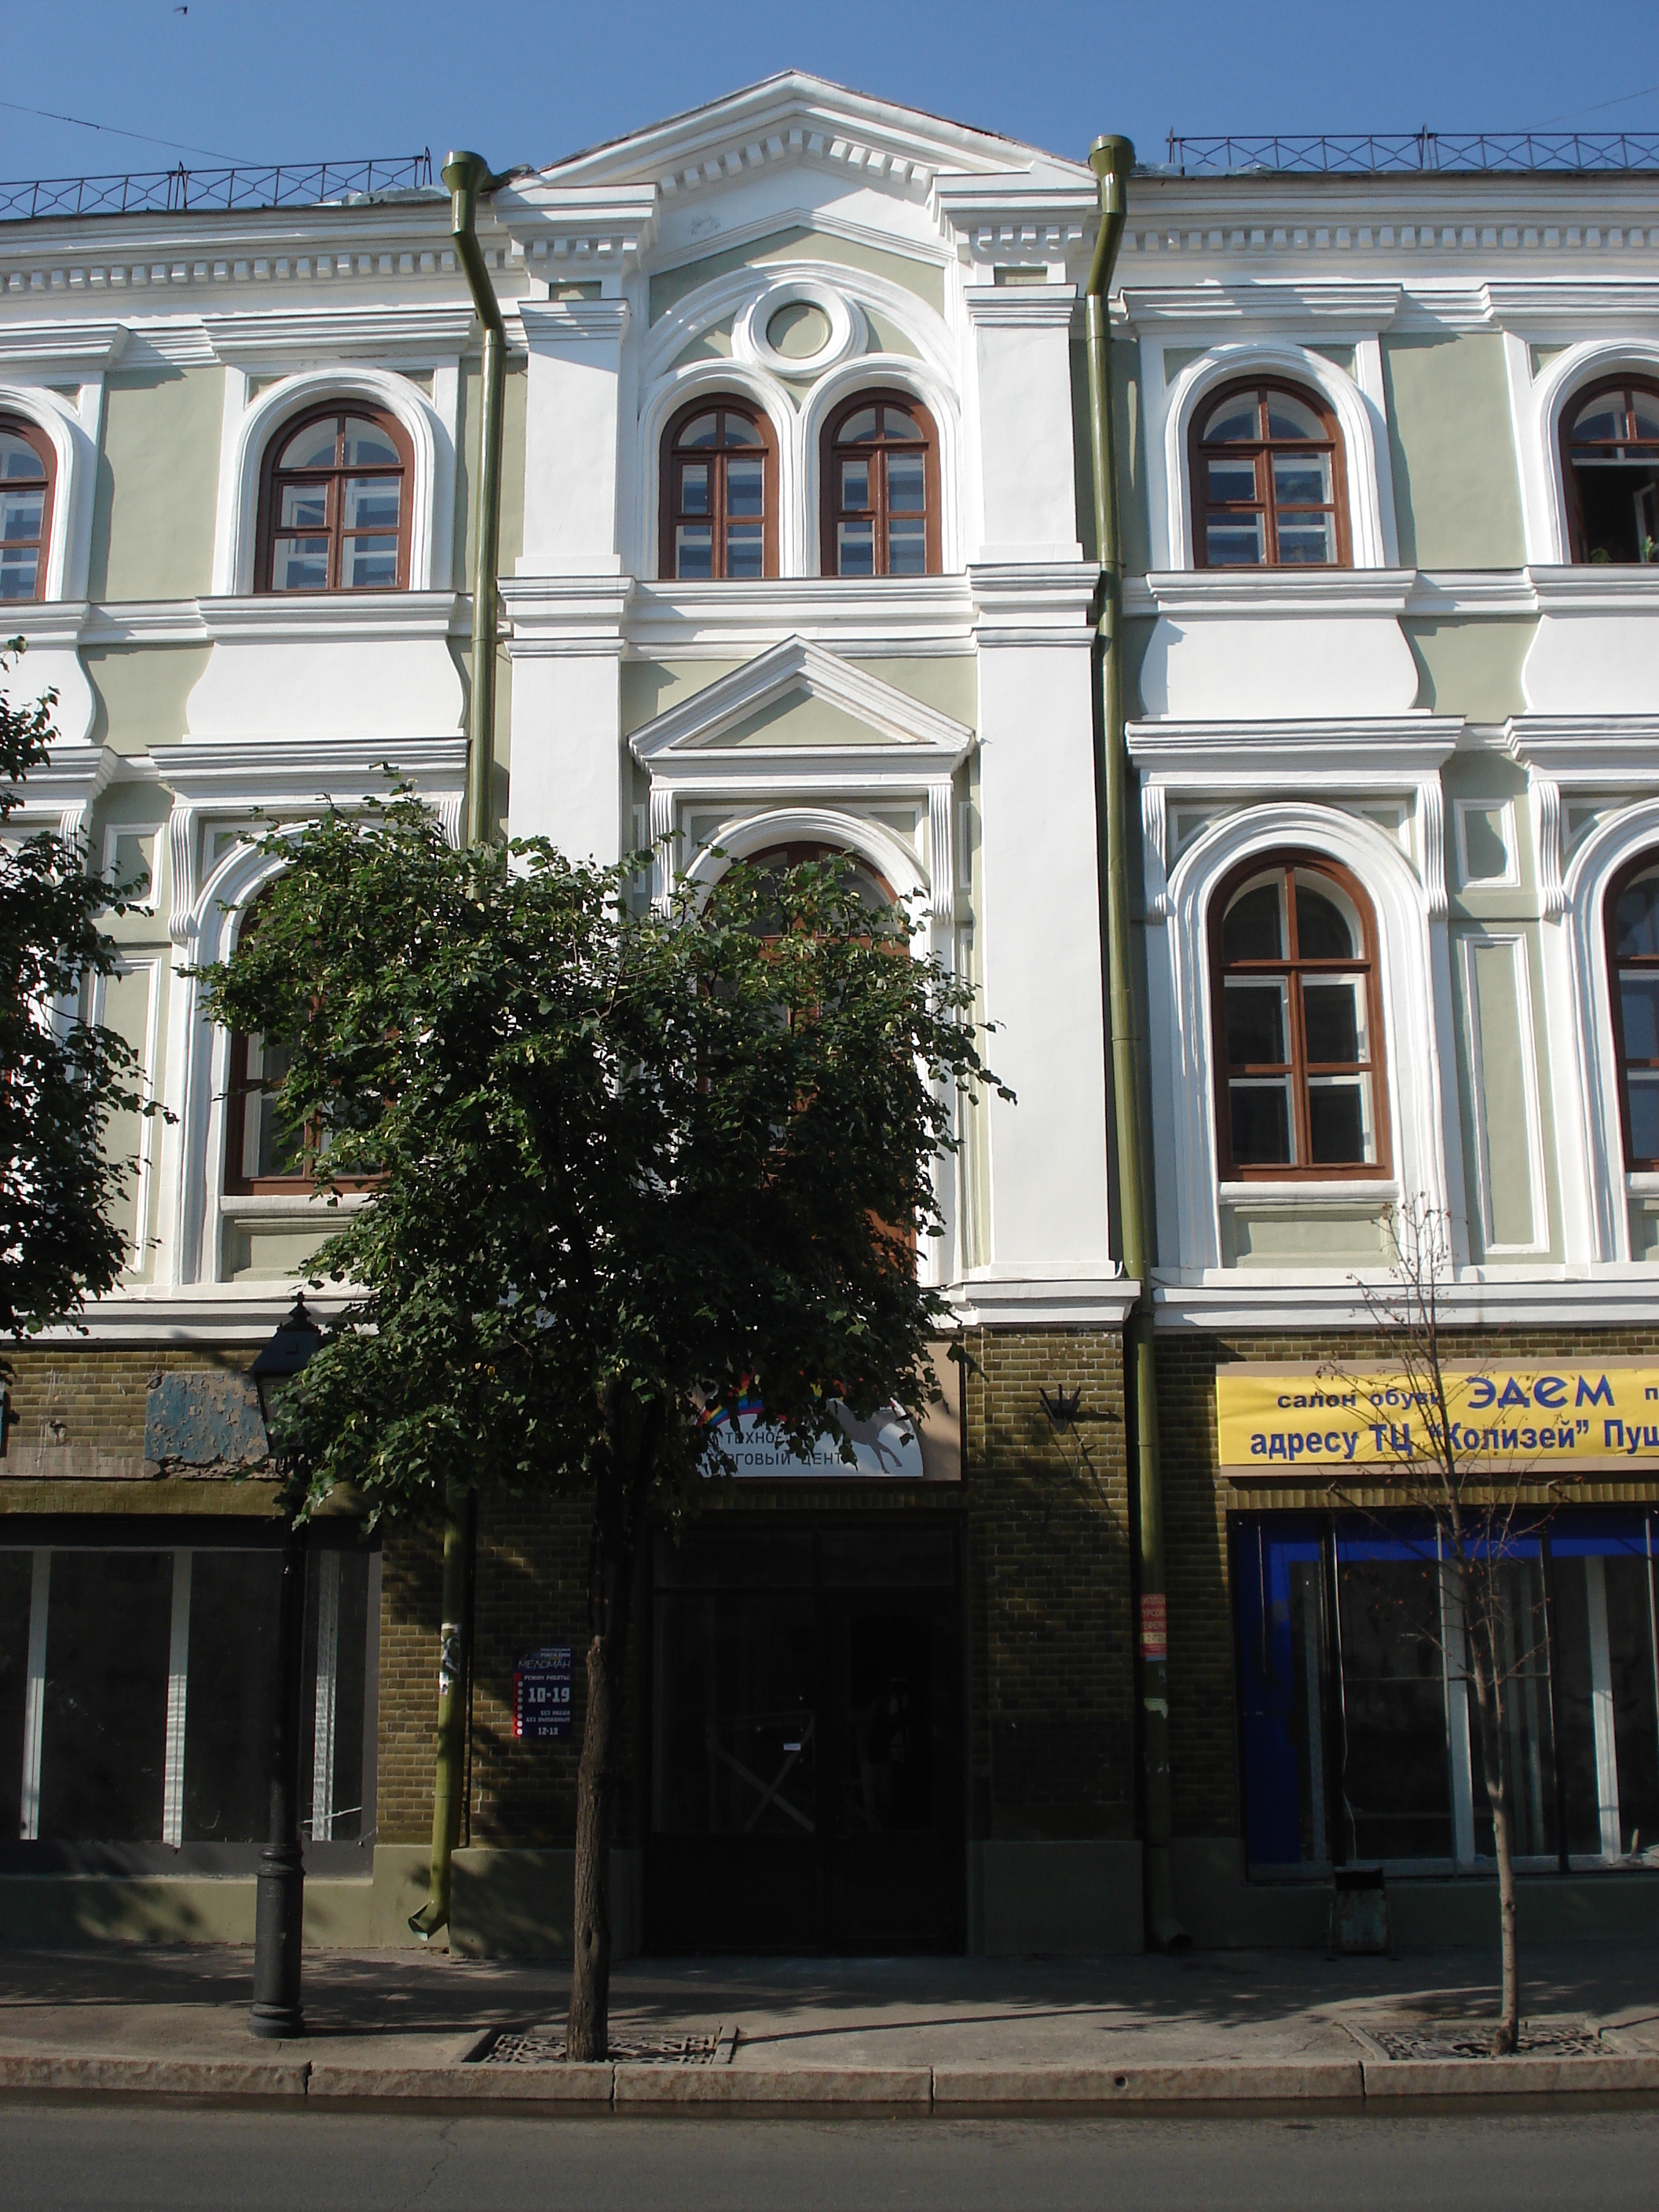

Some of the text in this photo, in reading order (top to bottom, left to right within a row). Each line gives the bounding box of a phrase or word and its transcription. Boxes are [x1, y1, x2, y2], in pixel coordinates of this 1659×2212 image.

[1277, 1393, 1357, 1408] салон
[1251, 1430, 1359, 1461] адресу
[1369, 1423, 1413, 1458] ТЦ
[801, 1452, 844, 1467] ЦЕНТ
[518, 1659, 571, 1669] МЕЛОМАН
[528, 1686, 571, 1704] 10-19
